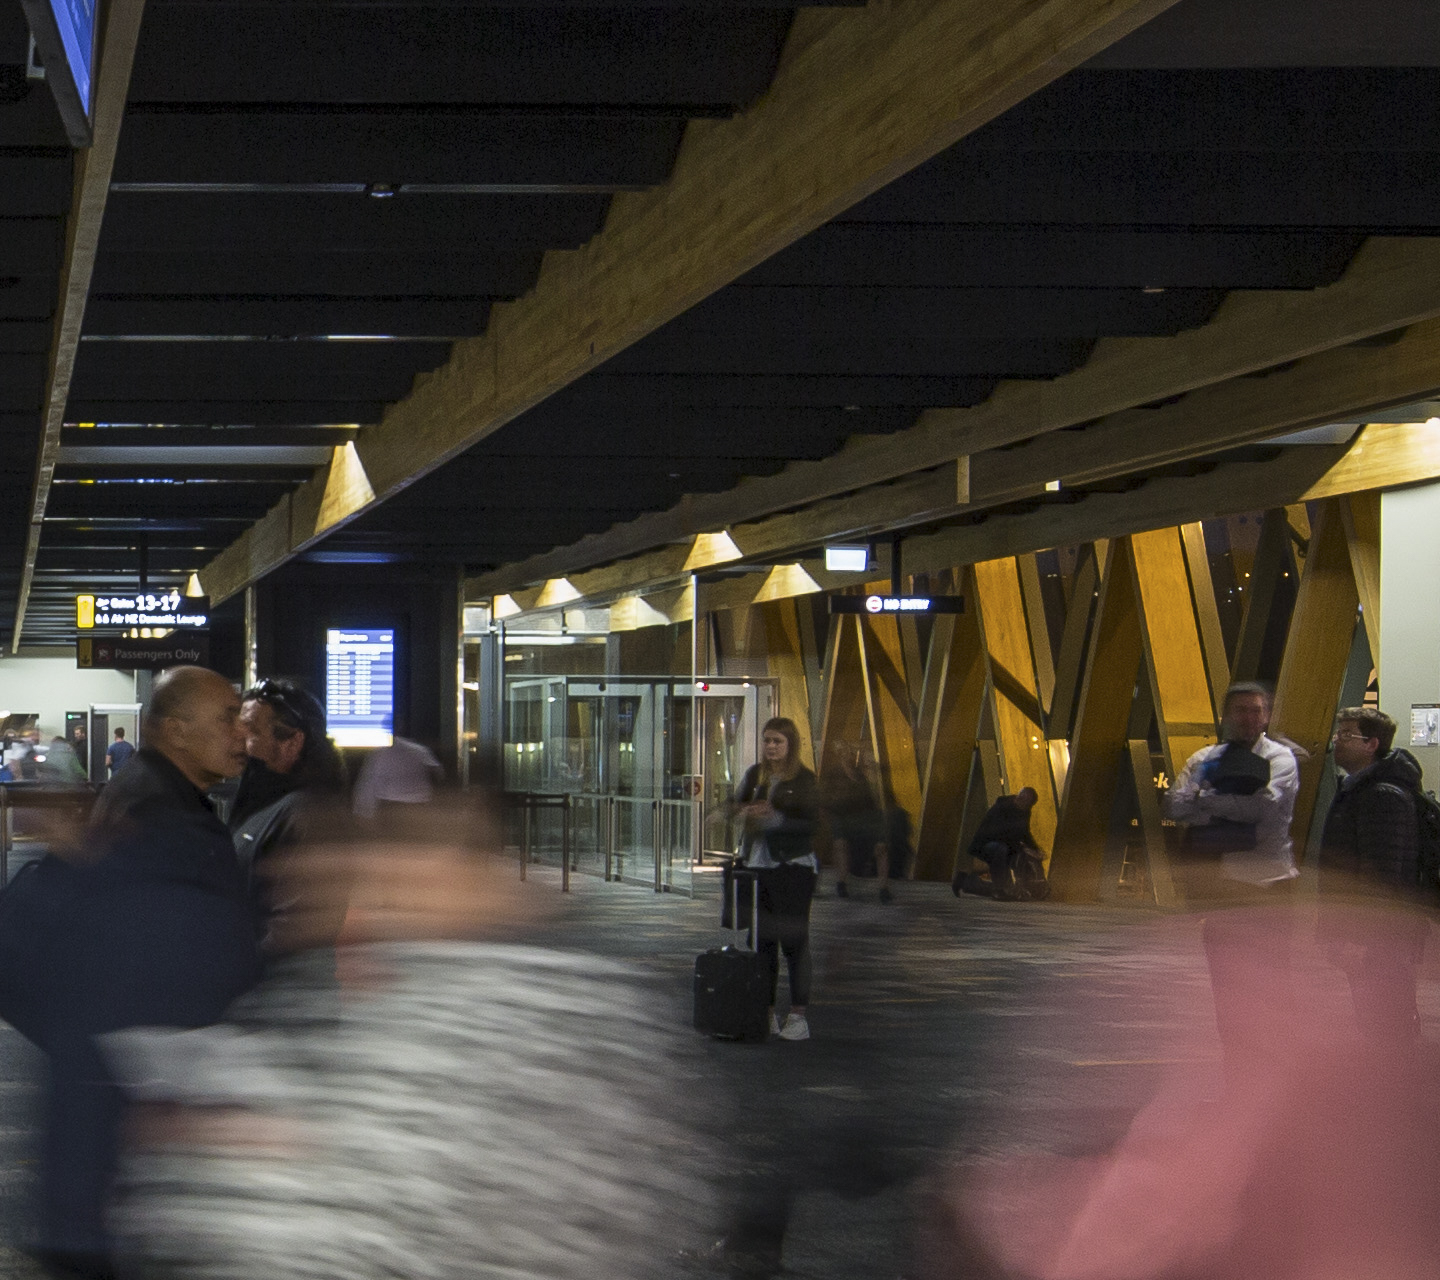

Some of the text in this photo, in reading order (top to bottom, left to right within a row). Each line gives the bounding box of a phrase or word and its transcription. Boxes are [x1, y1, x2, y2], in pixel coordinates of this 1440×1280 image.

[135, 594, 181, 612] 13-17
[115, 648, 200, 662] Passengers Only
